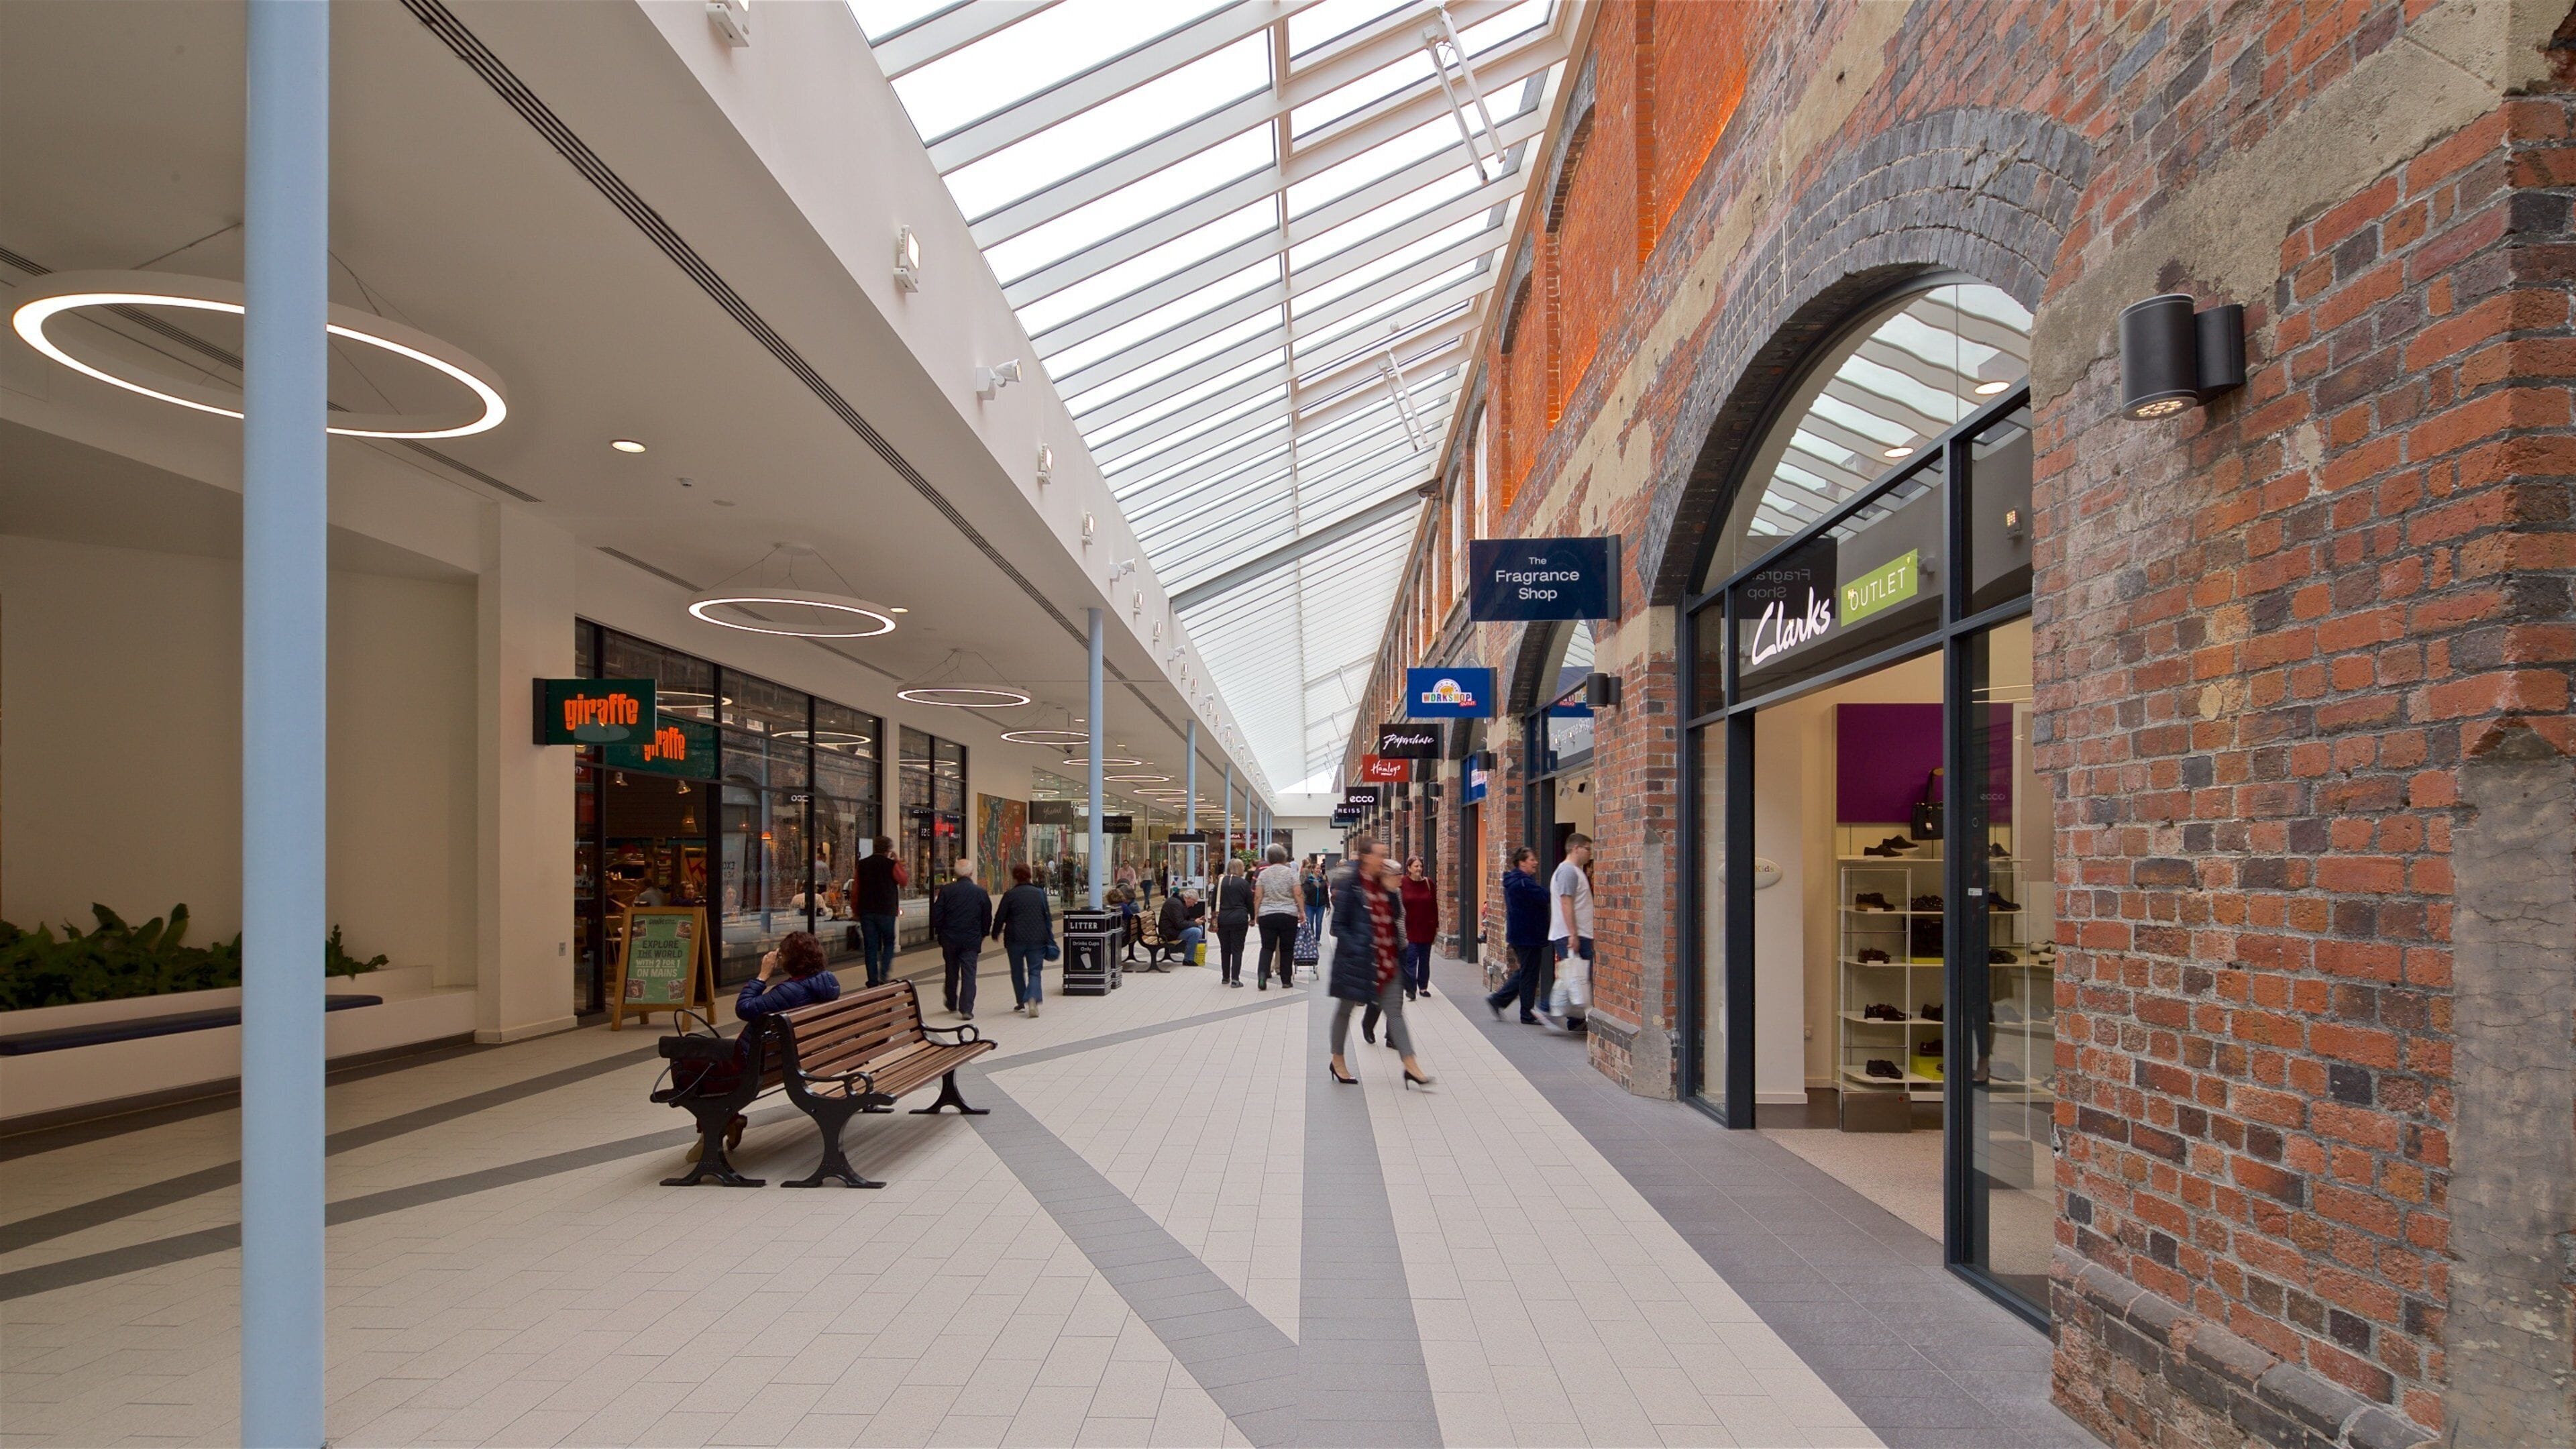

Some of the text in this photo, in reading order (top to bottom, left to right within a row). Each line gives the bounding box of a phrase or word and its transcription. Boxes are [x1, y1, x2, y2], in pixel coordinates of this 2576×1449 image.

[1528, 557, 1547, 565] The
[1495, 570, 1580, 585] Fragrance
[1849, 566, 1906, 612] OUTLET
[1518, 588, 1558, 602] Shop
[1752, 586, 1831, 665] Clarks
[1423, 694, 1471, 702] WORKSHOP
[564, 694, 639, 731] giraffe
[1371, 760, 1401, 776] Hamleys
[1070, 922, 1098, 930] LITTER
[642, 940, 679, 949] EXPLORE
[638, 949, 683, 958] THE WORLD
[655, 959, 661, 968] 2
[677, 959, 680, 968] 1
[637, 969, 678, 977] ON MAINS
